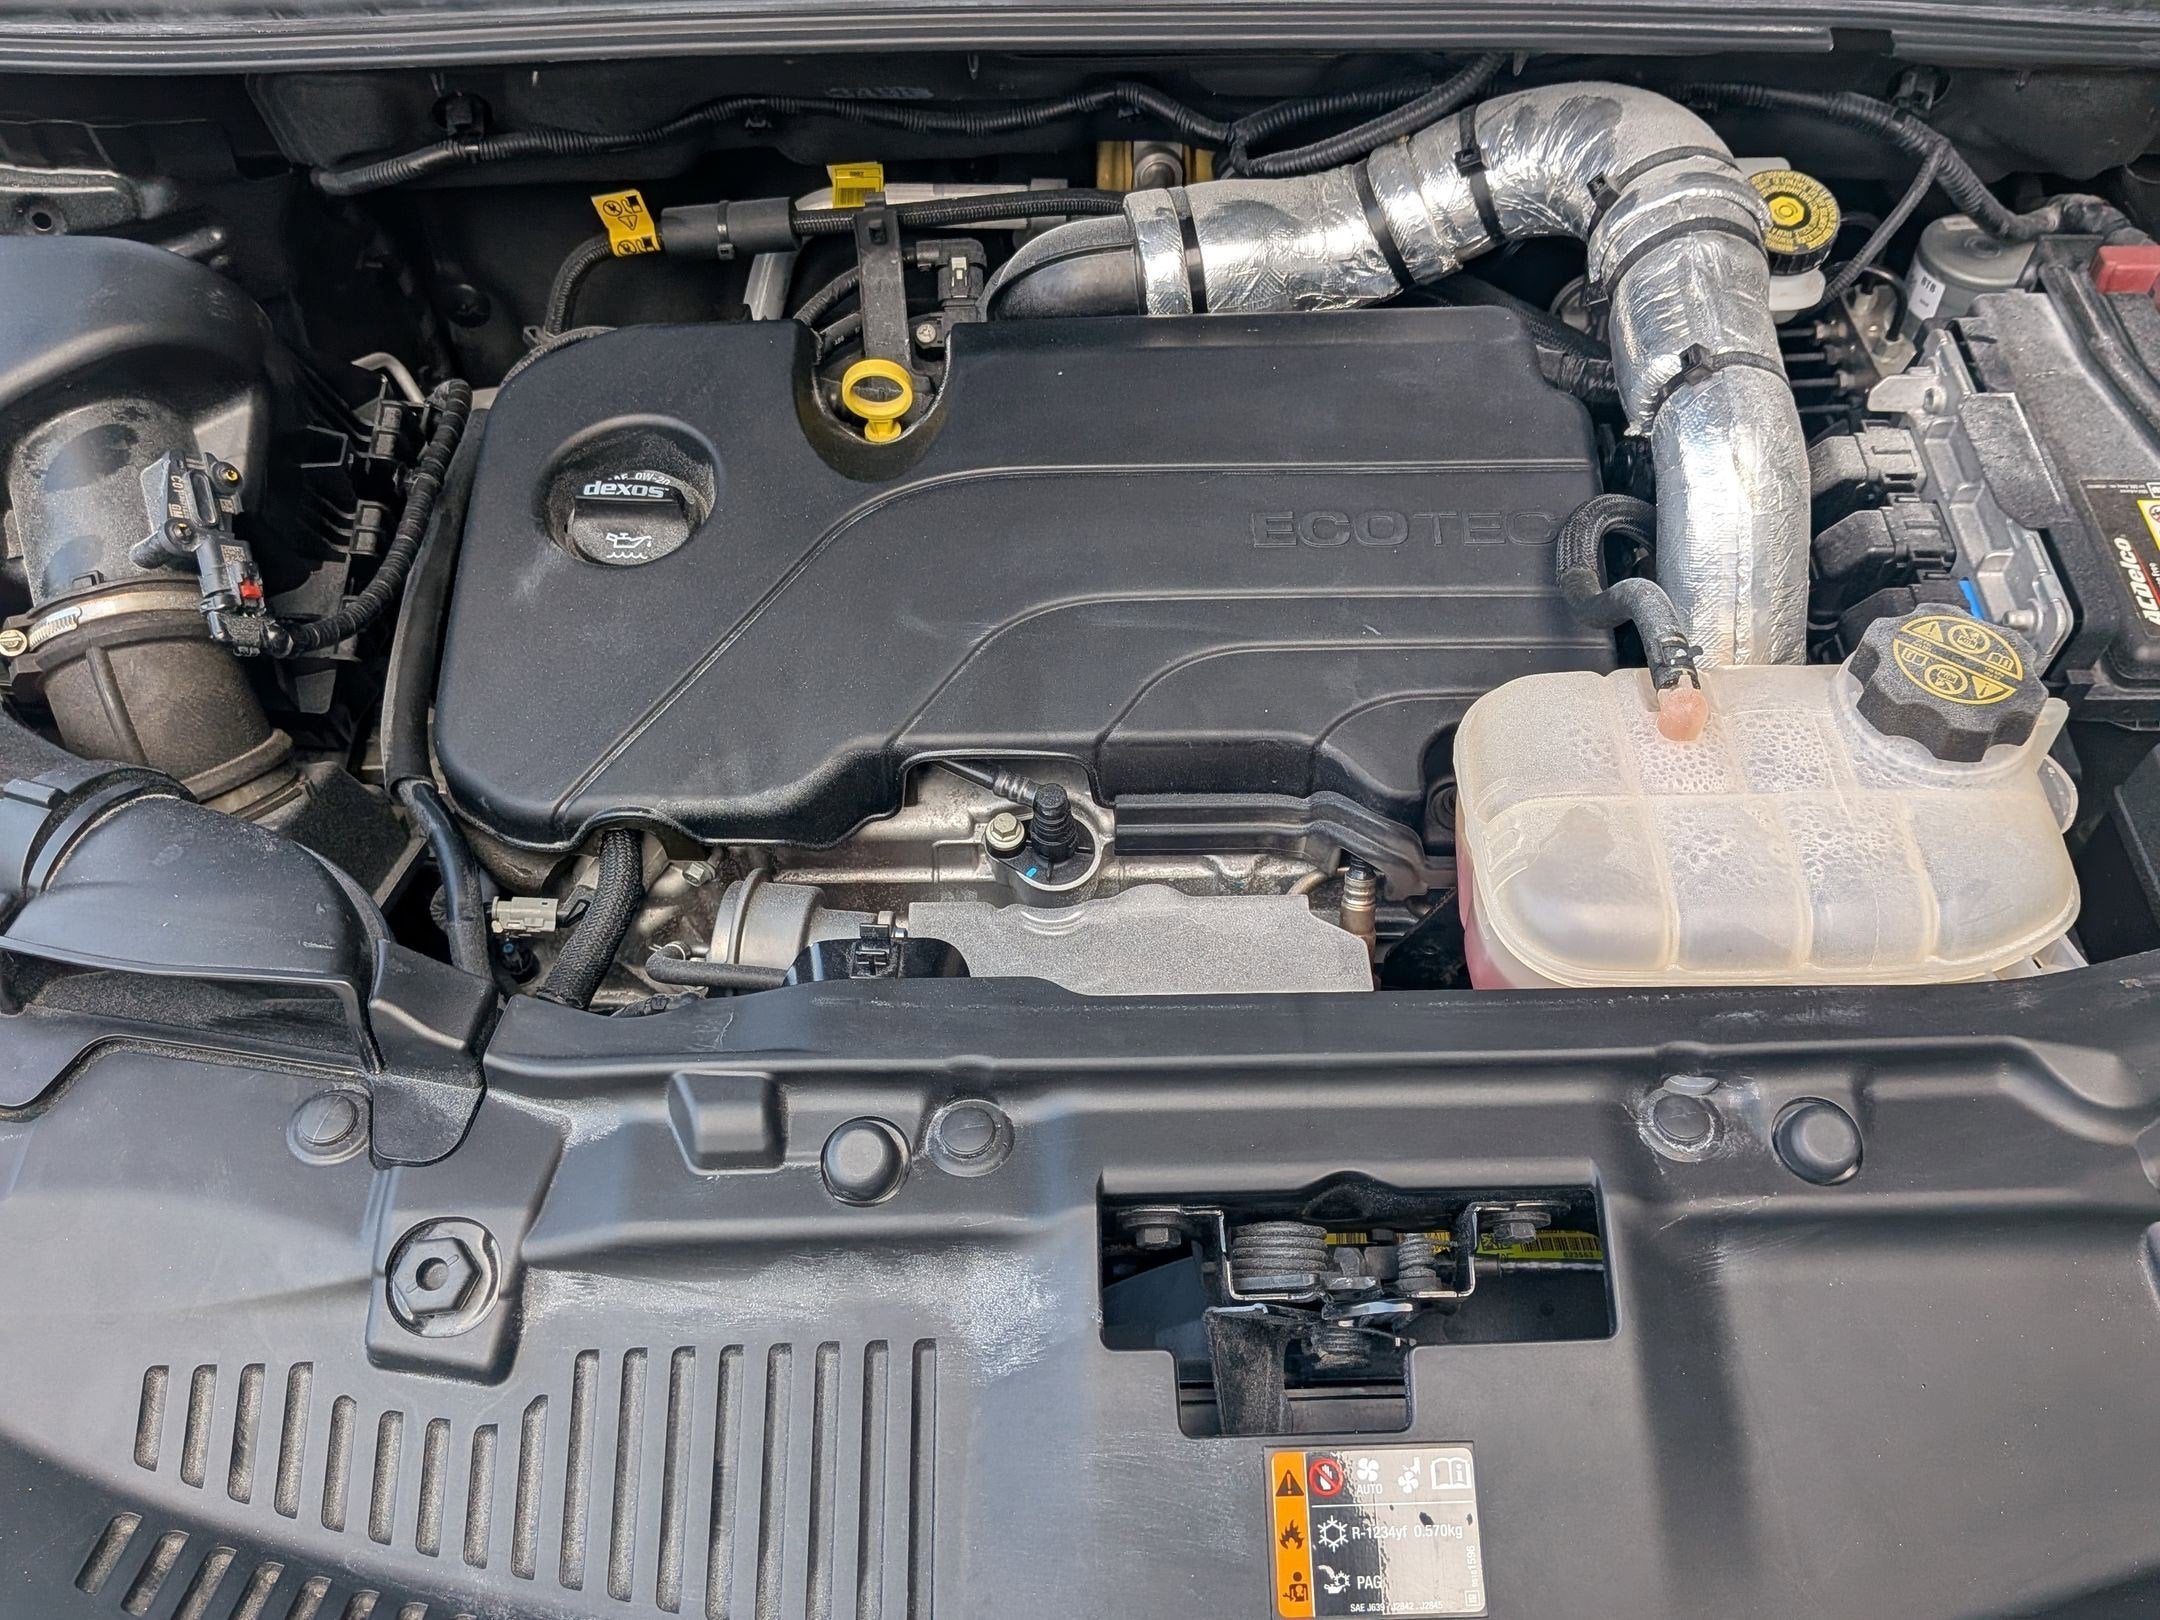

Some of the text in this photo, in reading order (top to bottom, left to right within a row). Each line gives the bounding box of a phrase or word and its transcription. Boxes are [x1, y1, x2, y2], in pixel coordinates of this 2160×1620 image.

[583, 480, 664, 498] dexos
[1250, 510, 1560, 548] ECOTEC
[2114, 536, 2160, 626] ACDelco
[1356, 1483, 1383, 1495] AUTO
[1352, 1523, 1463, 1541] R-1234yf 0.570kg
[1357, 1575, 1383, 1590] PAG
[1350, 1603, 1366, 1613] SAE
